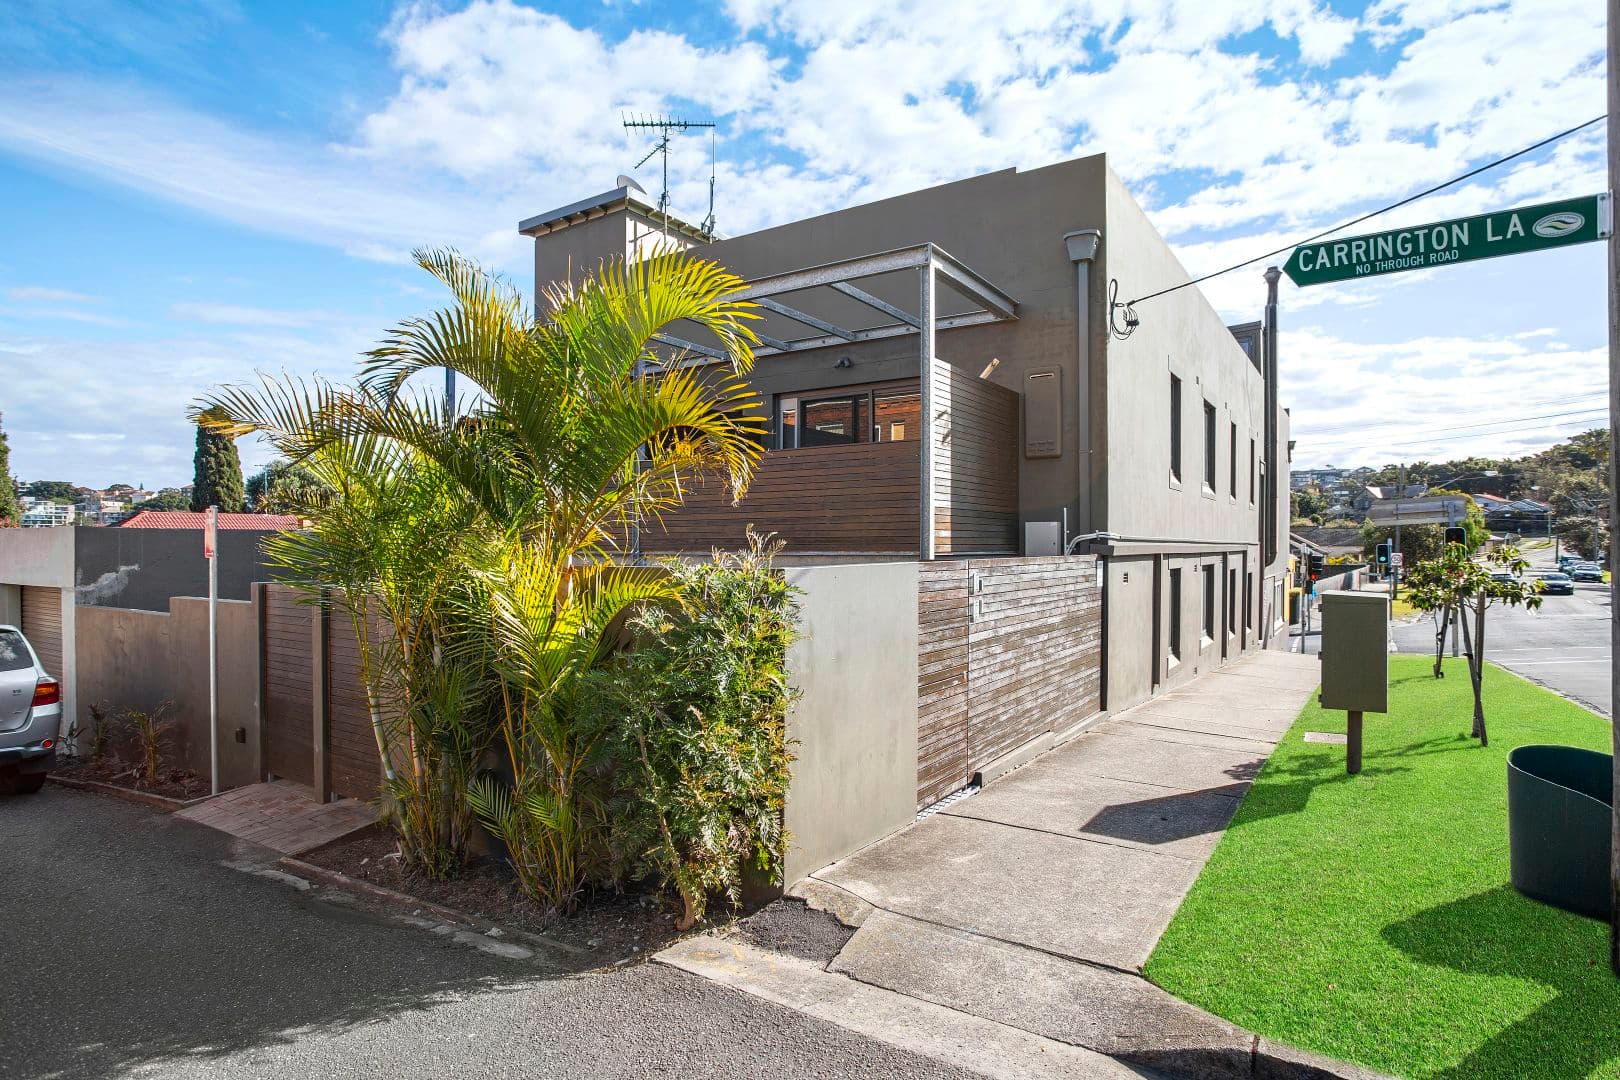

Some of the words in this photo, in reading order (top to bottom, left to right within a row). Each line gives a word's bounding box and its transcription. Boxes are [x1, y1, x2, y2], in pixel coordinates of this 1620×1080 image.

[1299, 222, 1468, 272] CARRINGTON
[1486, 213, 1525, 242] LA
[1356, 263, 1371, 275] NO
[1375, 255, 1424, 271] THROUGH
[1430, 249, 1459, 263] ROAD
